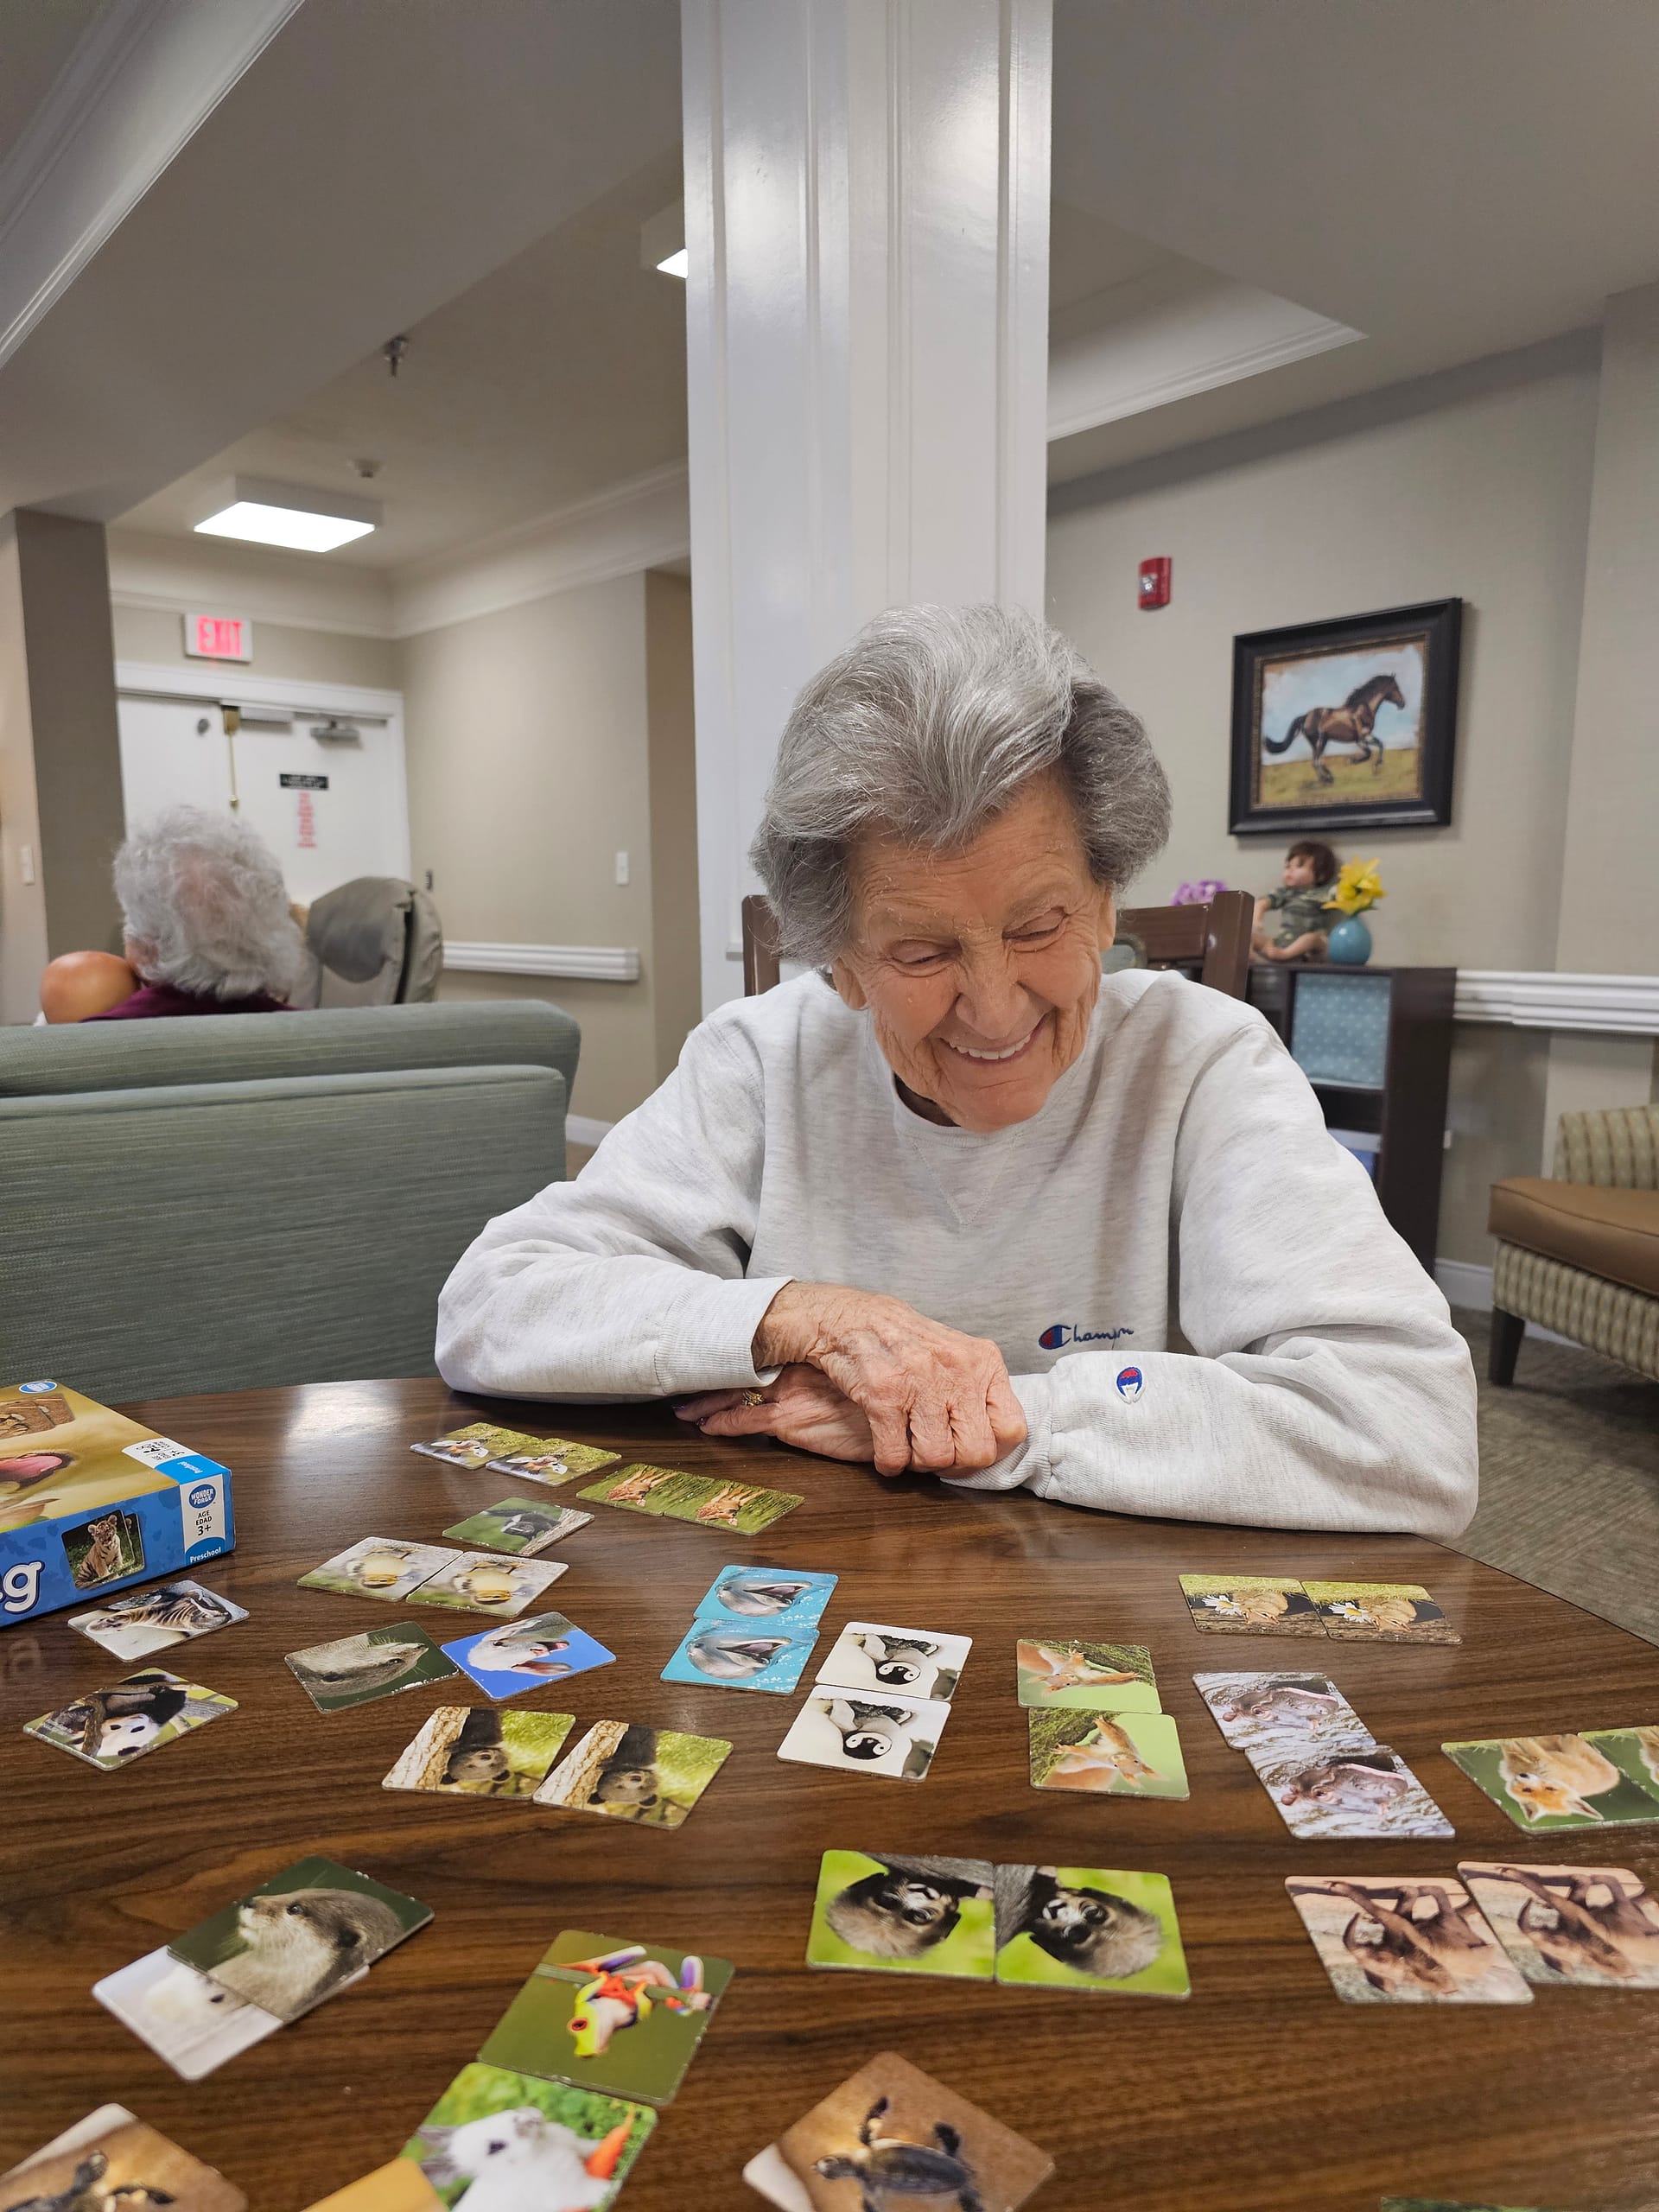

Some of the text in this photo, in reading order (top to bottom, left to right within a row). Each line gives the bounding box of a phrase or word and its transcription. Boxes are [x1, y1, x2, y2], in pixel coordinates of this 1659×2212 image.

[197, 615, 242, 657] EXIT
[191, 1488, 214, 1500] WONDER
[198, 1510, 210, 1519] AGE
[195, 1516, 213, 1526] EDAD
[197, 1524, 212, 1536] 3+
[189, 1546, 221, 1564] Preschool
[0, 1560, 43, 1613] g
